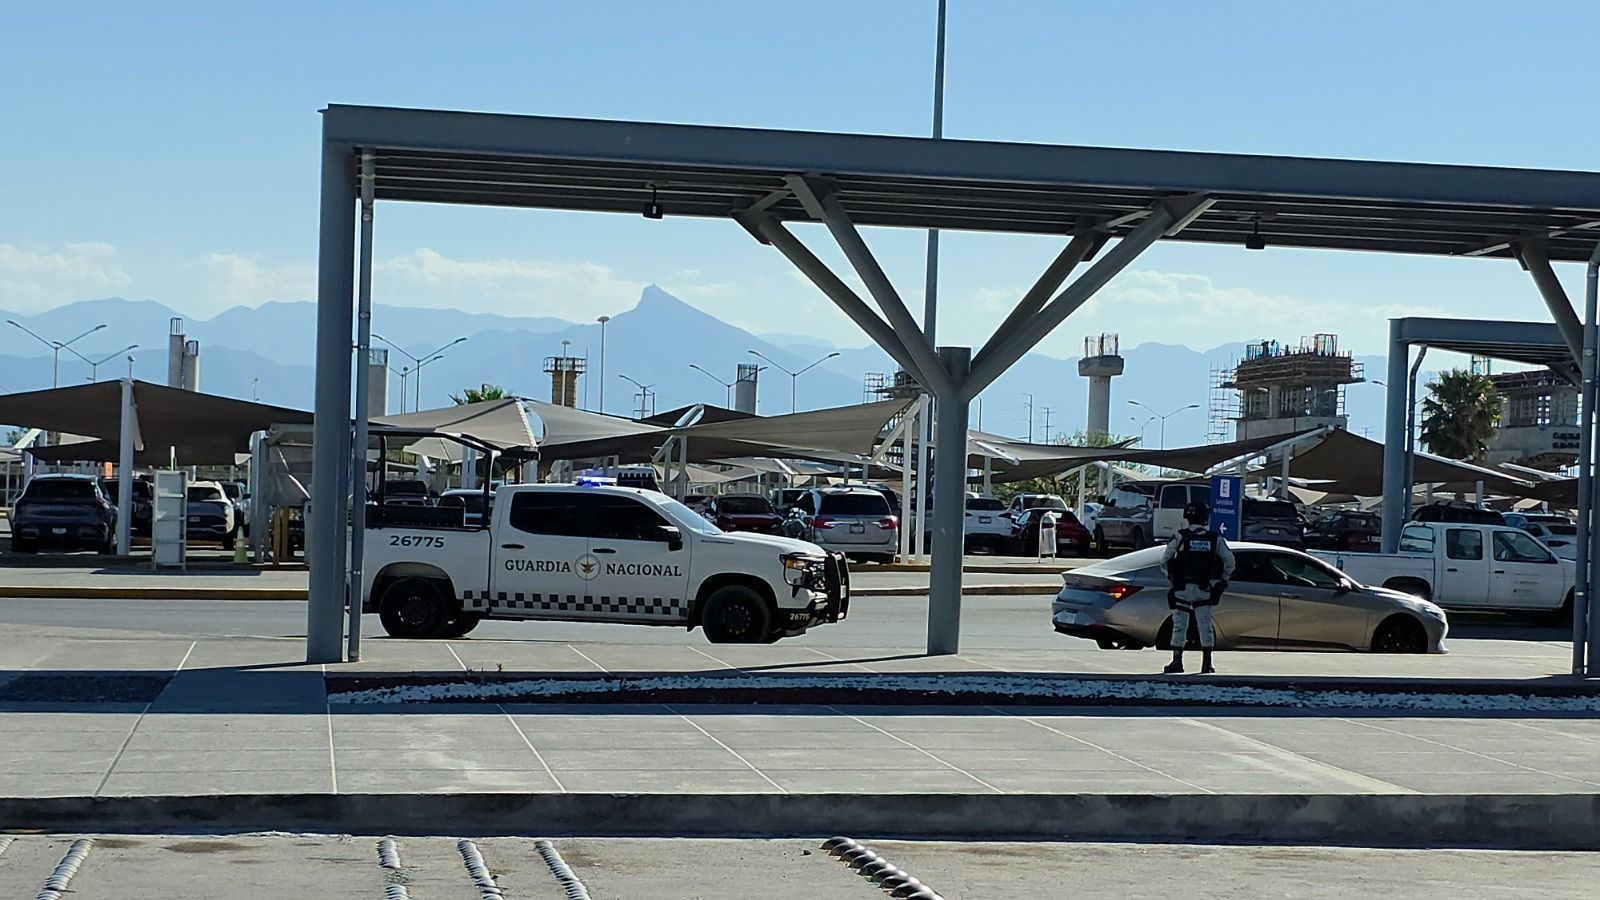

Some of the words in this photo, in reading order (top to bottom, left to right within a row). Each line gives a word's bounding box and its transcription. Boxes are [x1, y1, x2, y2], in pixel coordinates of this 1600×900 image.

[389, 535, 445, 548] 26775
[505, 559, 571, 572] GUARDIA
[606, 563, 682, 577] NACIONAL
